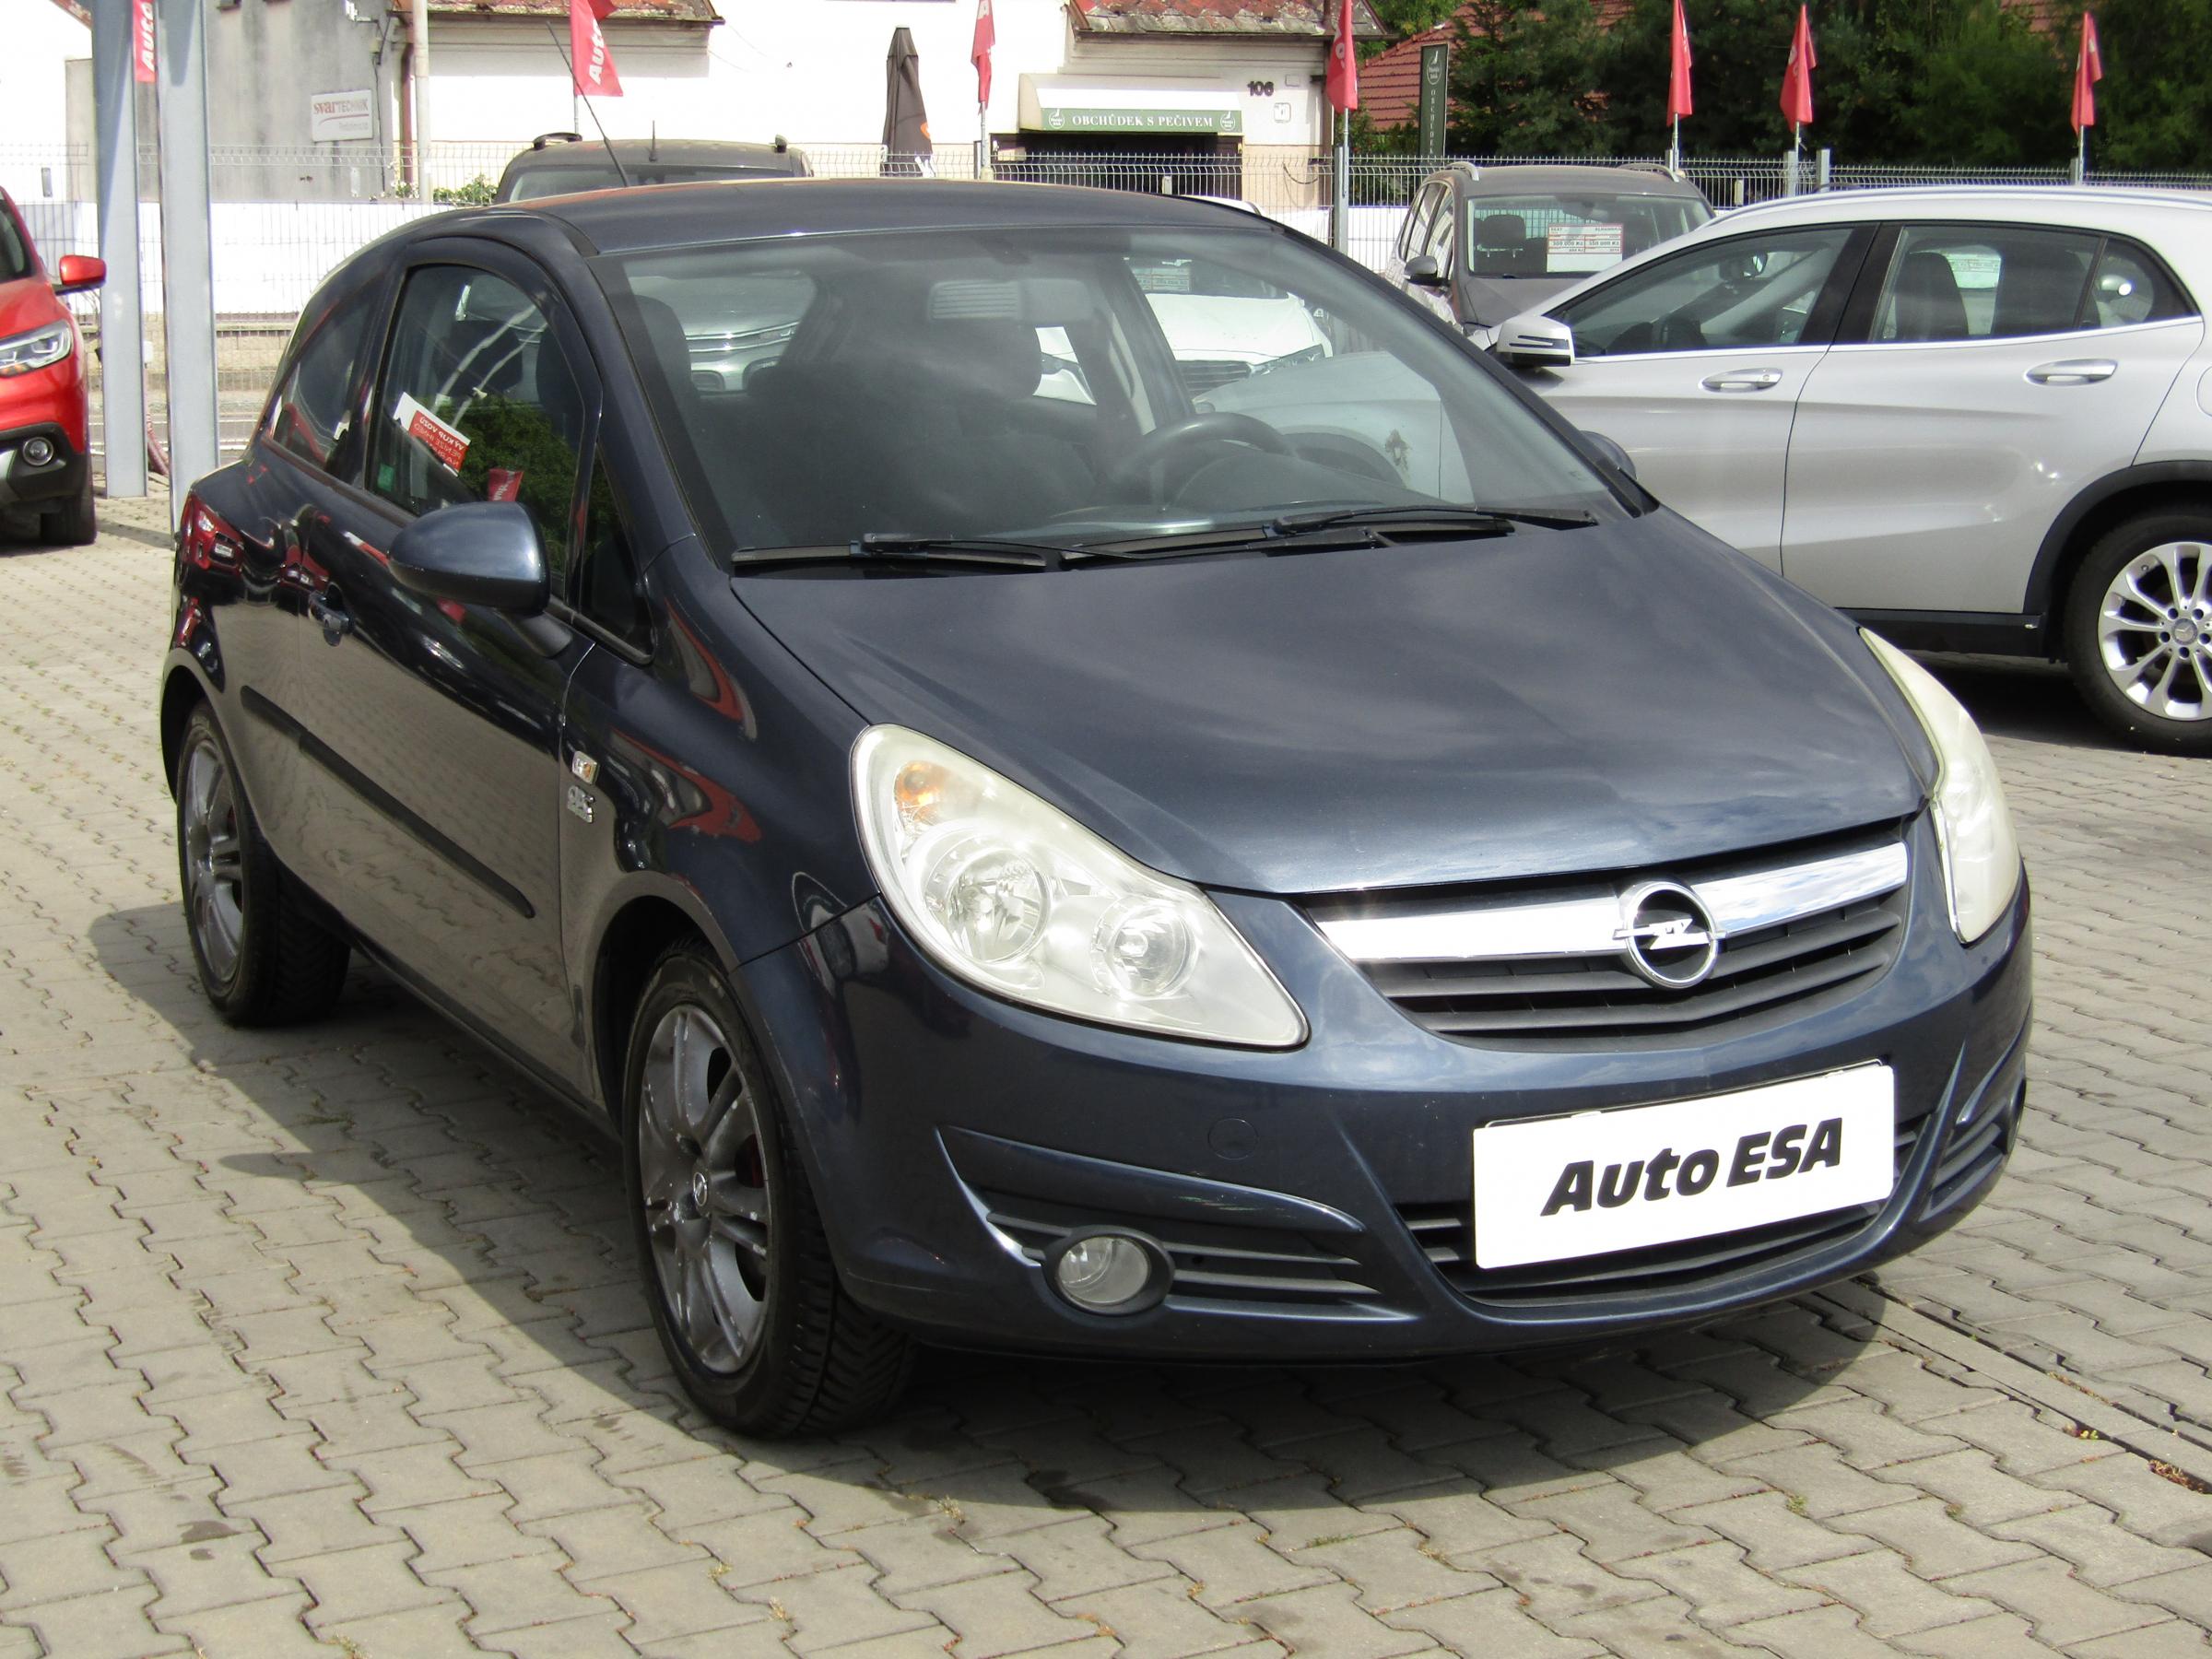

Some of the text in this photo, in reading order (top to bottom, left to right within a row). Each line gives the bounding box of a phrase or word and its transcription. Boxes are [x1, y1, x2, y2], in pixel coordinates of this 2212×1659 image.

[1247, 81, 1274, 97] 106
[1072, 113, 1144, 126] OBCHŮDEK
[1147, 116, 1154, 126] S
[1159, 114, 1213, 127] PEČIVEM
[1540, 1117, 1842, 1217] Auto ESA
